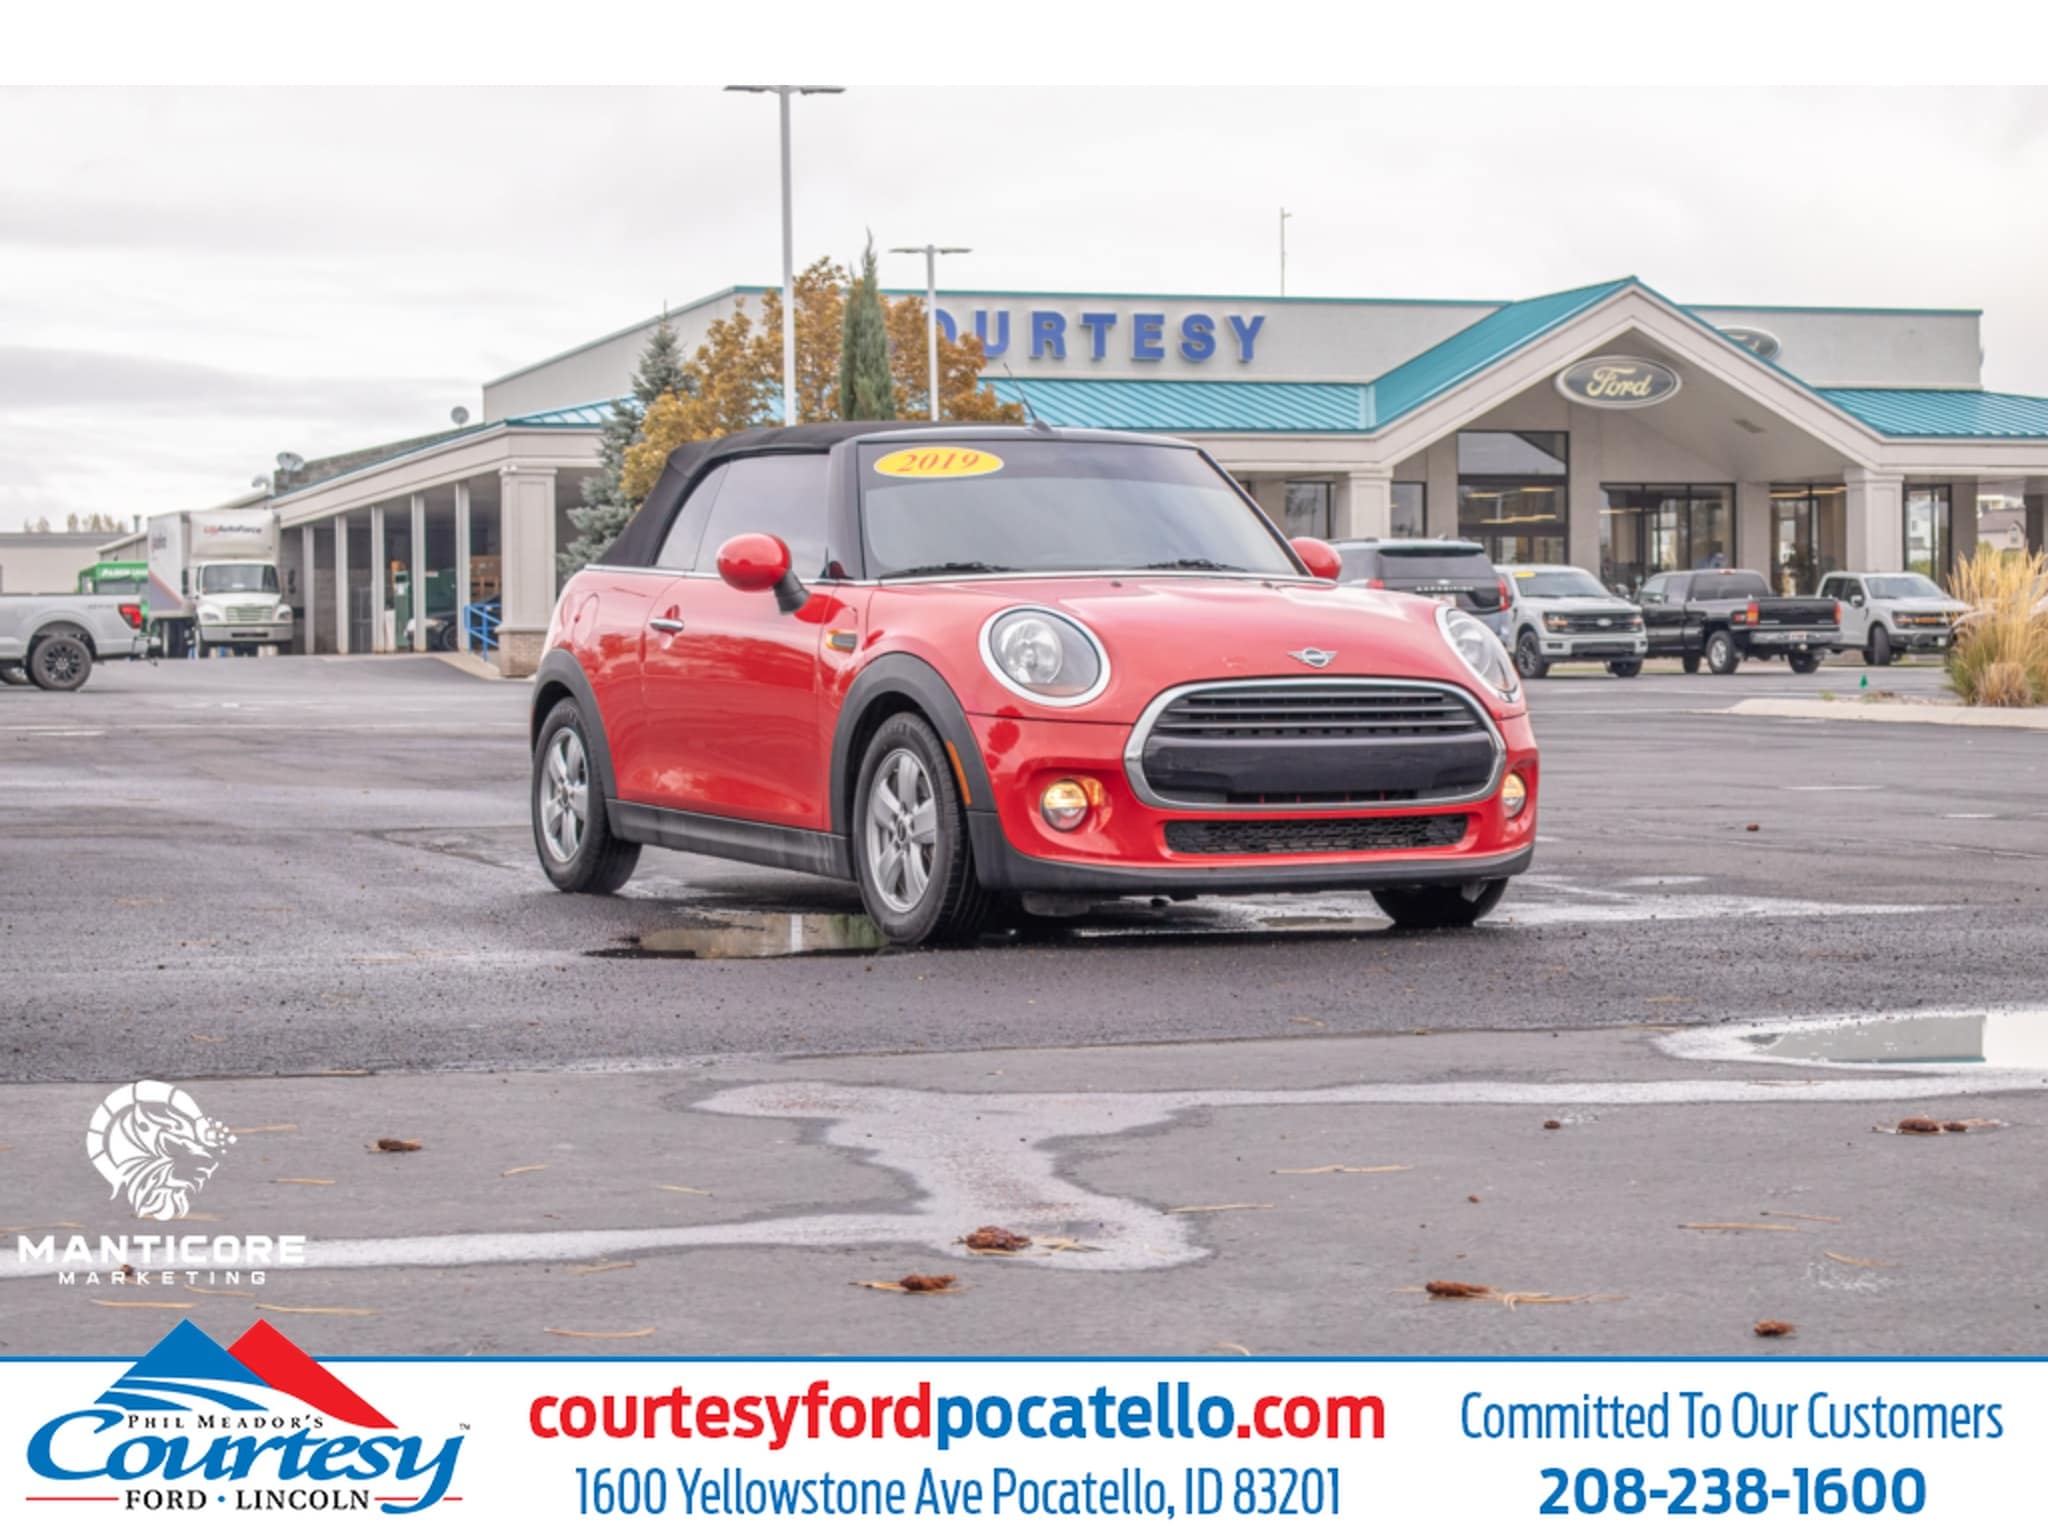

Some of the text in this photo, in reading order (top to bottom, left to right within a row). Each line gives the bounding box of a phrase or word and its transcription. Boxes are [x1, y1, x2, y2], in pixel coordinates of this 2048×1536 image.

[934, 308, 1267, 363] URTESY
[1586, 366, 1653, 397] Ford
[896, 452, 980, 473] 2019
